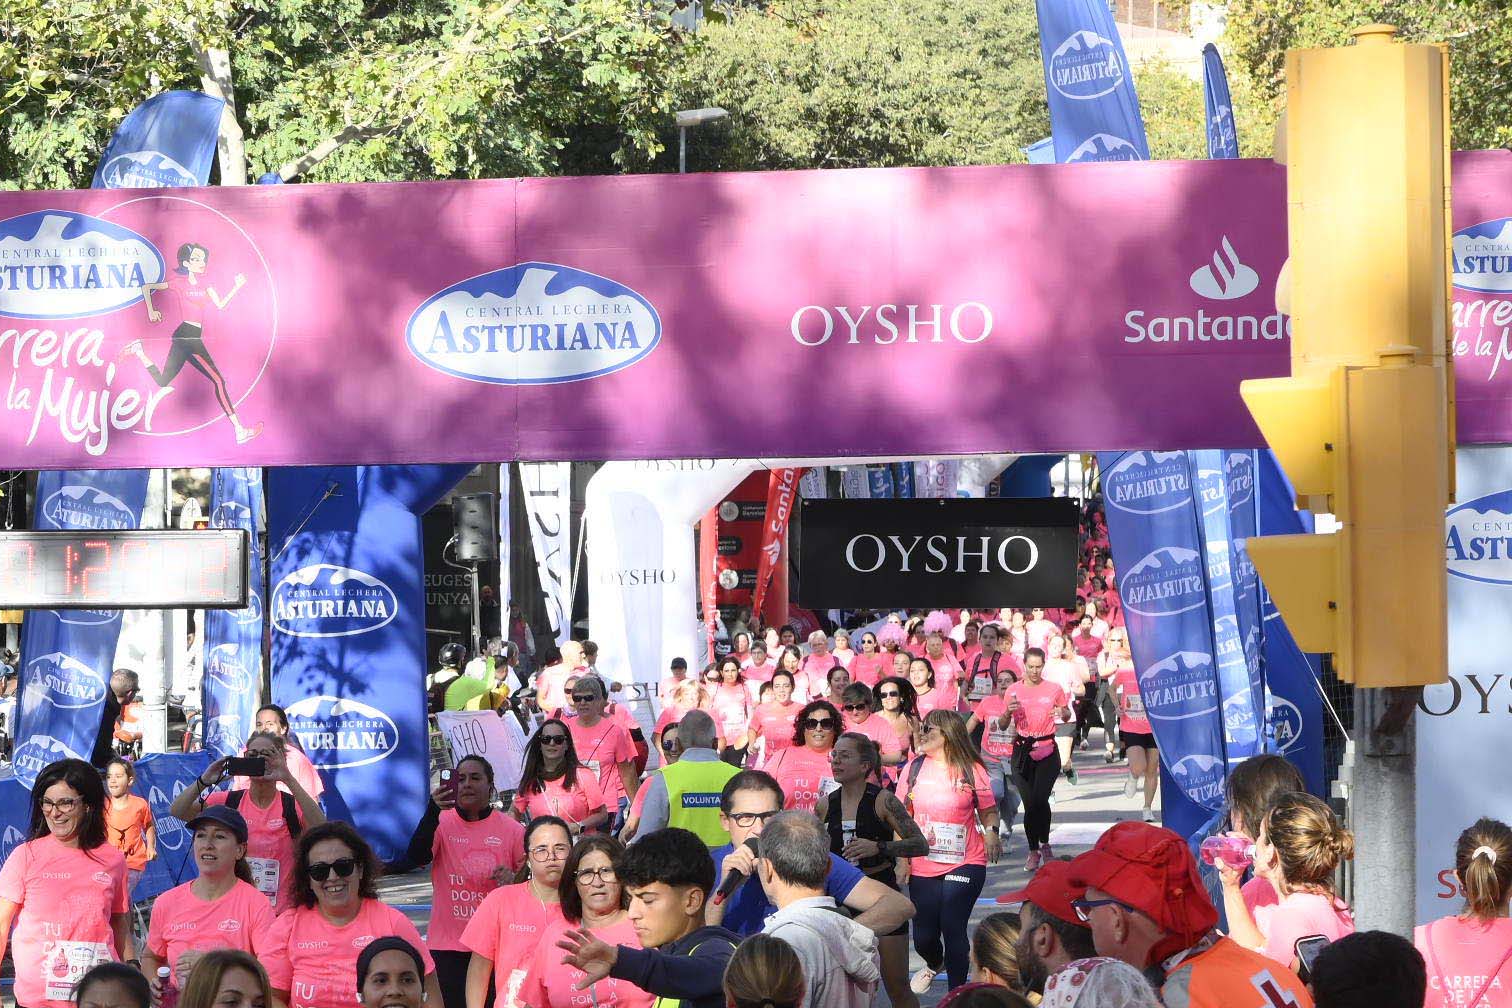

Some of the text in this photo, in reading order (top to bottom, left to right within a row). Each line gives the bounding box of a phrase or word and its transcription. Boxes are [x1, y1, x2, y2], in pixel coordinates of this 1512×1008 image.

[465, 303, 633, 318] CENTRAL LECHERA
[427, 309, 641, 354] ASTURIANA
[790, 302, 994, 346] OYSHO
[1124, 307, 1291, 343] Santand
[7, 372, 33, 411] la
[27, 360, 176, 456] Mujer
[845, 533, 1039, 575] OYSHO
[287, 587, 384, 598] CENTRAL LECHERA
[275, 595, 389, 619] ASTURIANA
[1417, 674, 1512, 717] OY
[682, 795, 722, 806] VOLUNTA
[449, 874, 465, 887] TU
[451, 889, 489, 902] DORS
[294, 981, 316, 1000] TU
